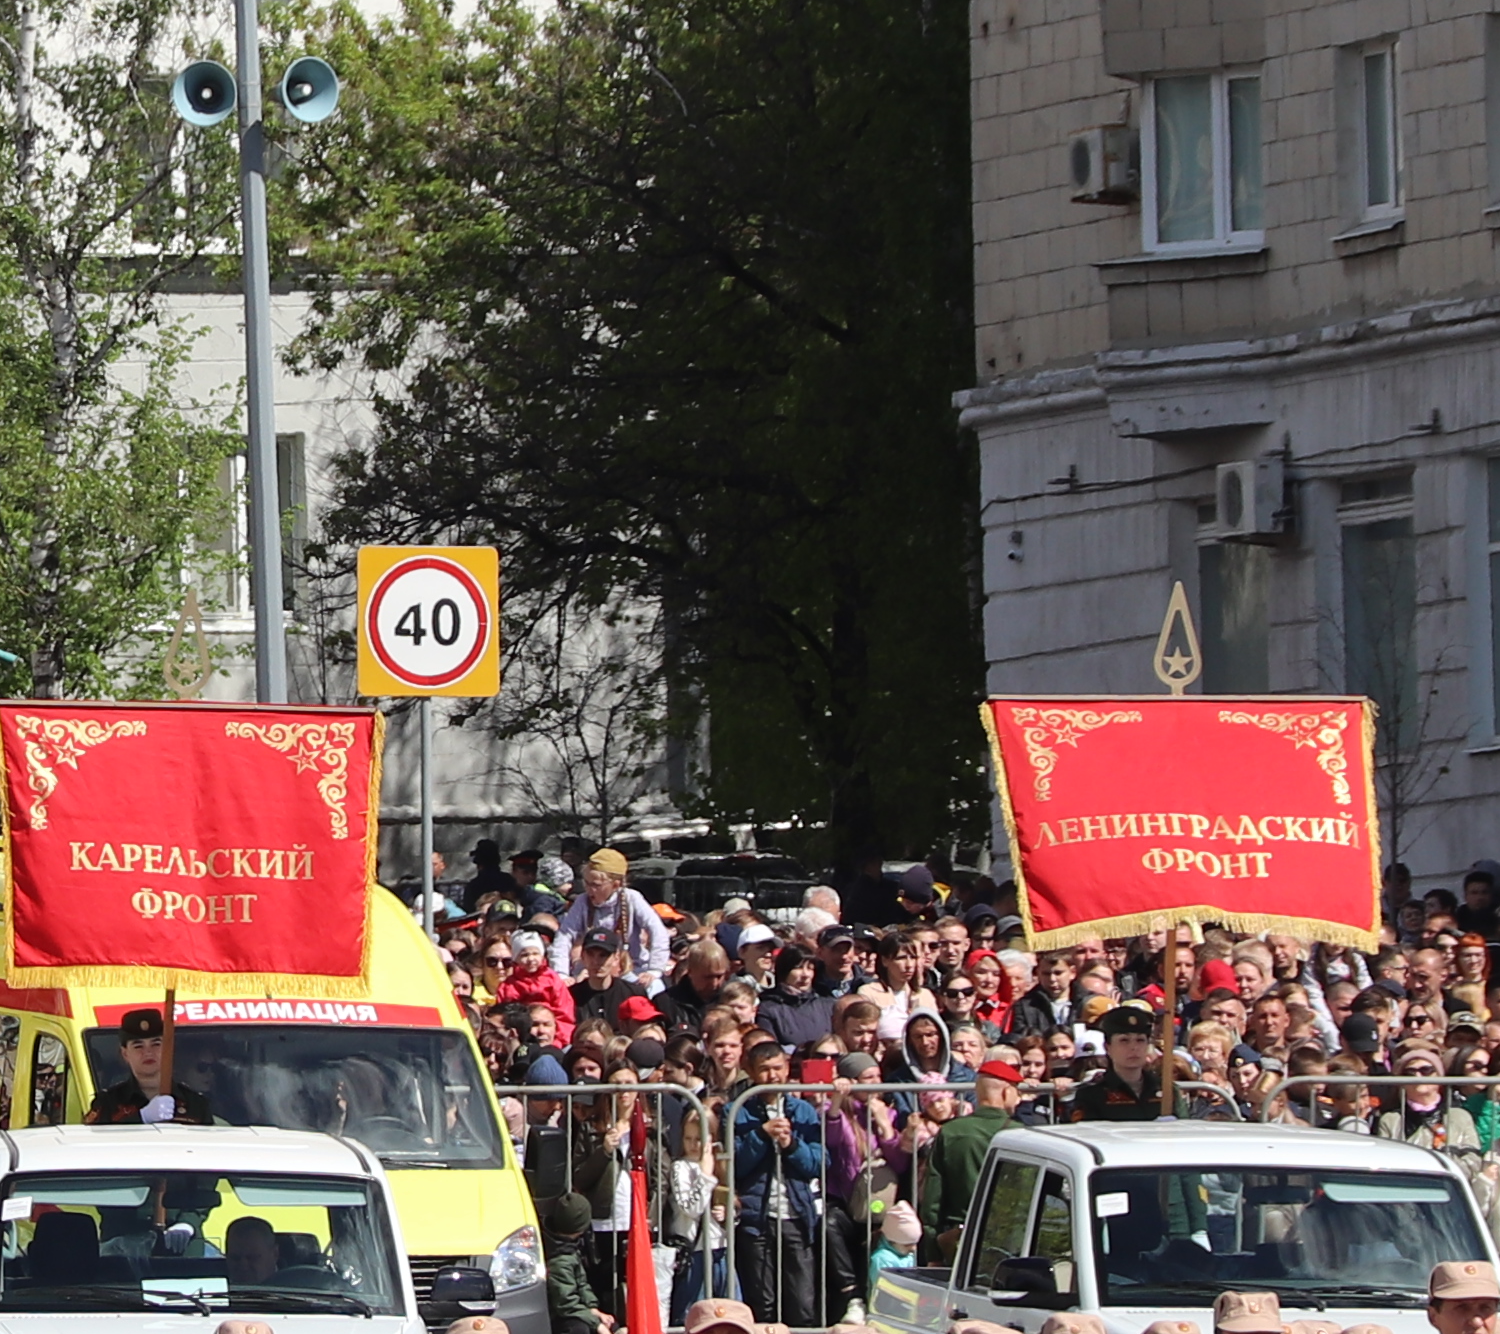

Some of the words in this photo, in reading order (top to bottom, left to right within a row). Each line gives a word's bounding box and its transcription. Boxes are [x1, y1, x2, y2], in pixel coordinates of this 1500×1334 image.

[394, 598, 461, 646] 40
[1033, 812, 1361, 850] ЛЕНИНГРАДСКИЙ
[69, 841, 315, 880] КАРЕЛЬСКИЙ
[1141, 848, 1272, 879] ФРОНТ
[131, 887, 257, 925] ФРОНТ
[173, 1001, 378, 1022] РЕАНИМАЦИЯ
